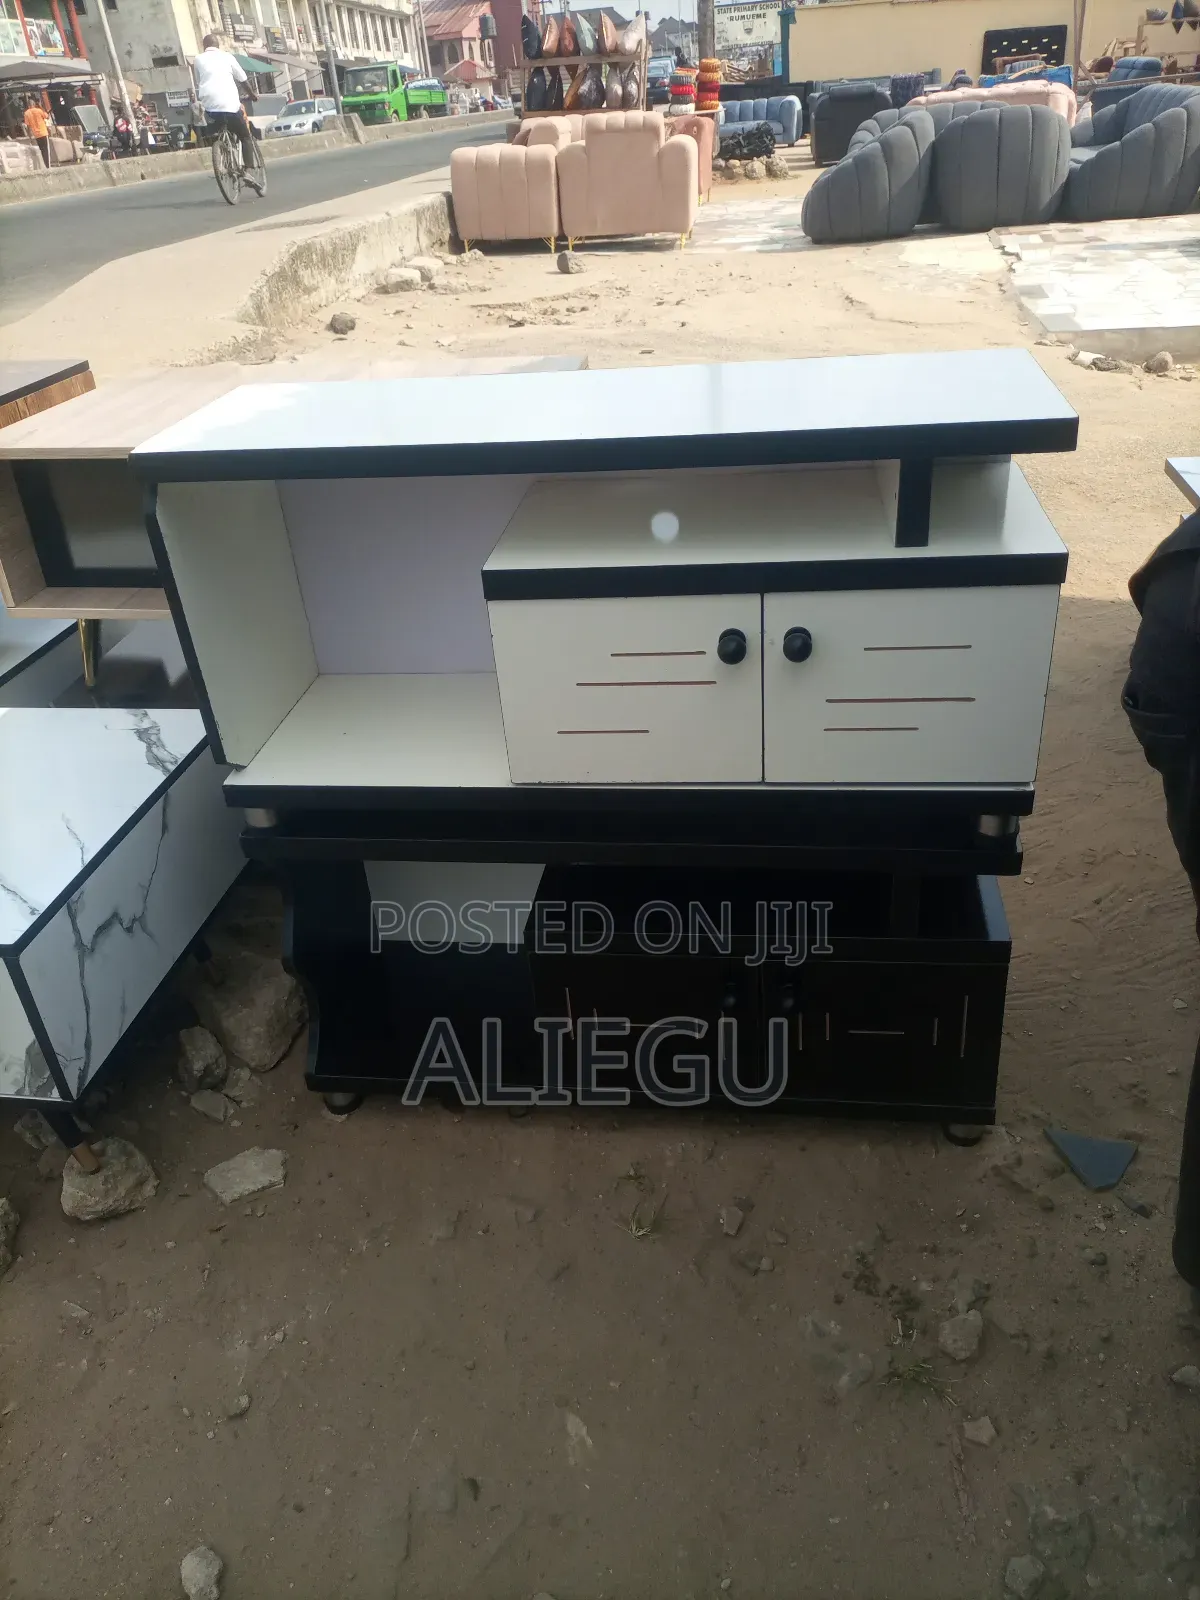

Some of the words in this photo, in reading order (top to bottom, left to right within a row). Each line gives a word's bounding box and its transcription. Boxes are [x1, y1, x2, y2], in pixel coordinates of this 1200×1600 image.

[717, 7, 732, 15] STATE
[734, 4, 758, 13] PRIMARY
[759, 2, 780, 10] SCHOOL
[729, 12, 767, 22] RUMUEME
